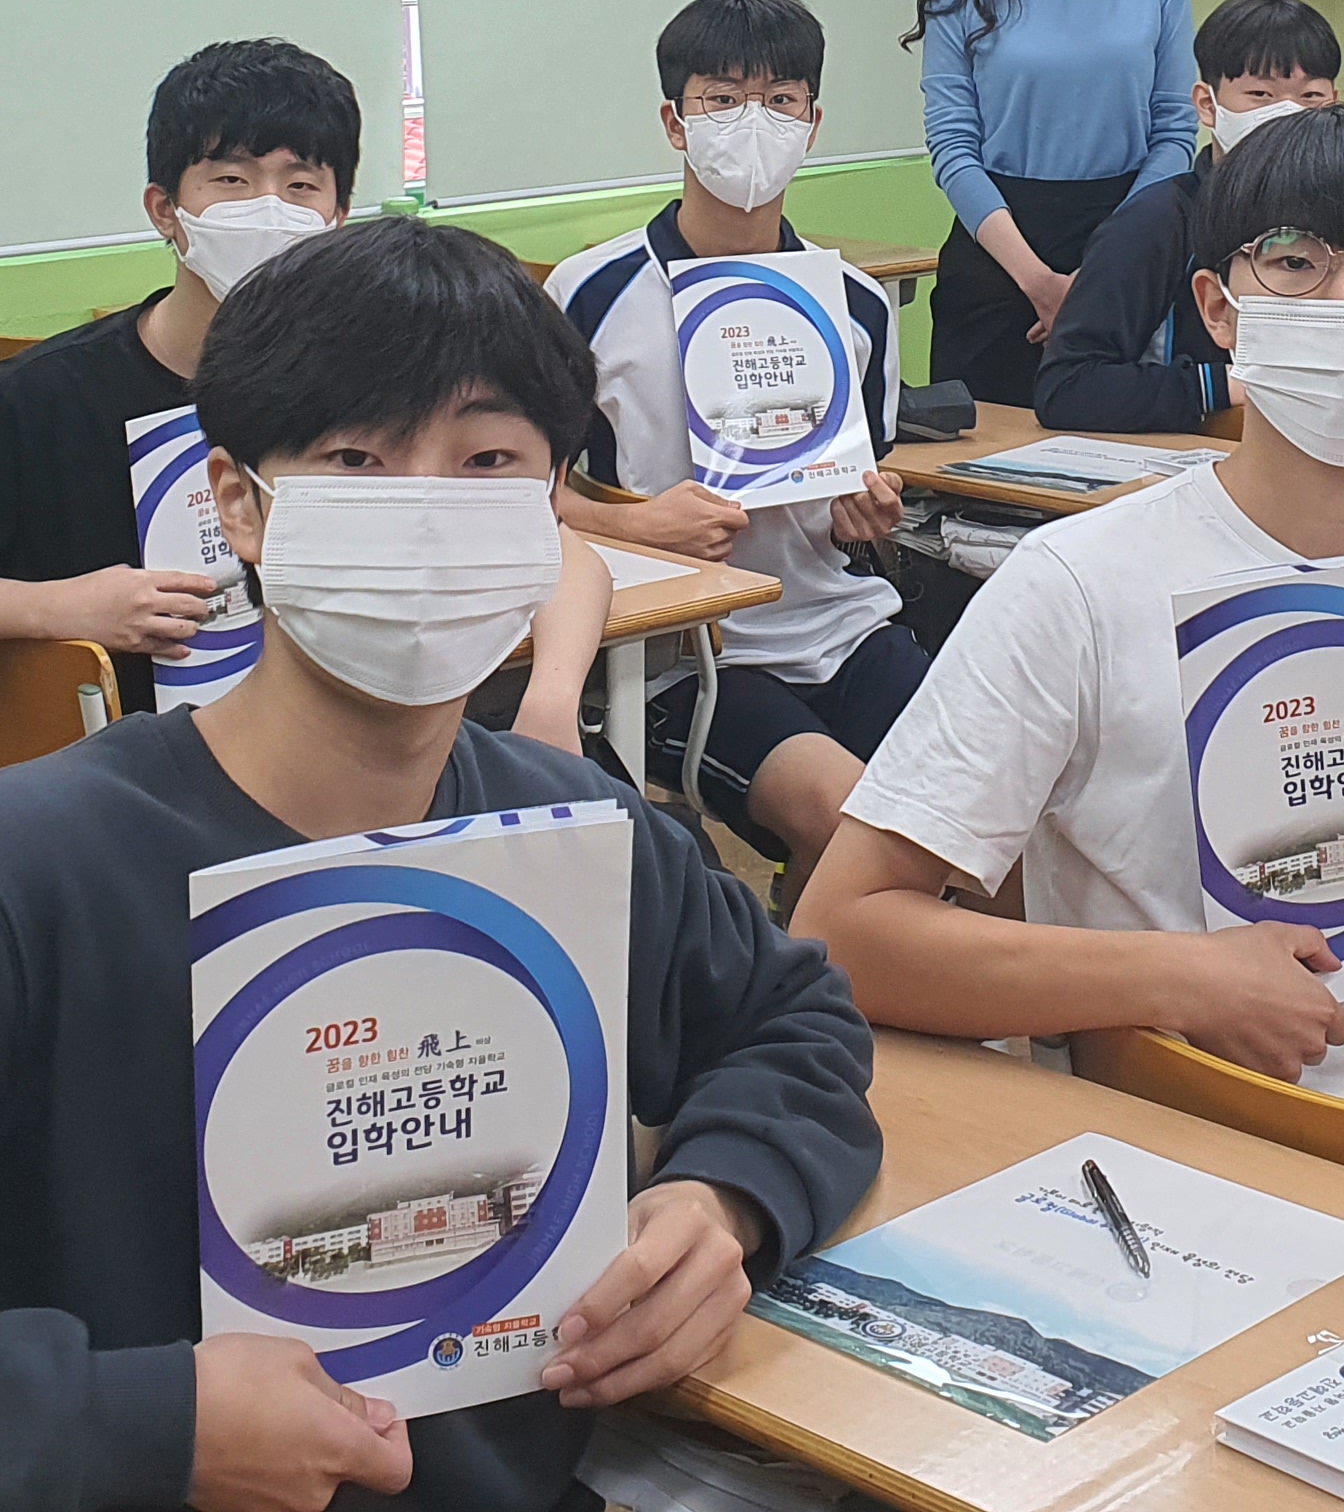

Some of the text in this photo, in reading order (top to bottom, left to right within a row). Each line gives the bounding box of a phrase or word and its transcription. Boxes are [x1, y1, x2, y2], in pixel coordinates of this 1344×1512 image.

[720, 326, 750, 338] 2023
[732, 355, 807, 372] 진해고등학교
[734, 370, 794, 389] 입학안내
[187, 489, 212, 508] 202
[1262, 696, 1316, 723] 2023
[305, 1017, 378, 1054] 2023
[326, 1057, 352, 1074] 꿈을
[358, 1052, 381, 1068] 향한
[417, 1029, 472, 1059] 飛上
[326, 1069, 508, 1127] 진해고등학교
[327, 1107, 472, 1166] 입학안내
[1253, 1375, 1344, 1423] 진해고등학교
